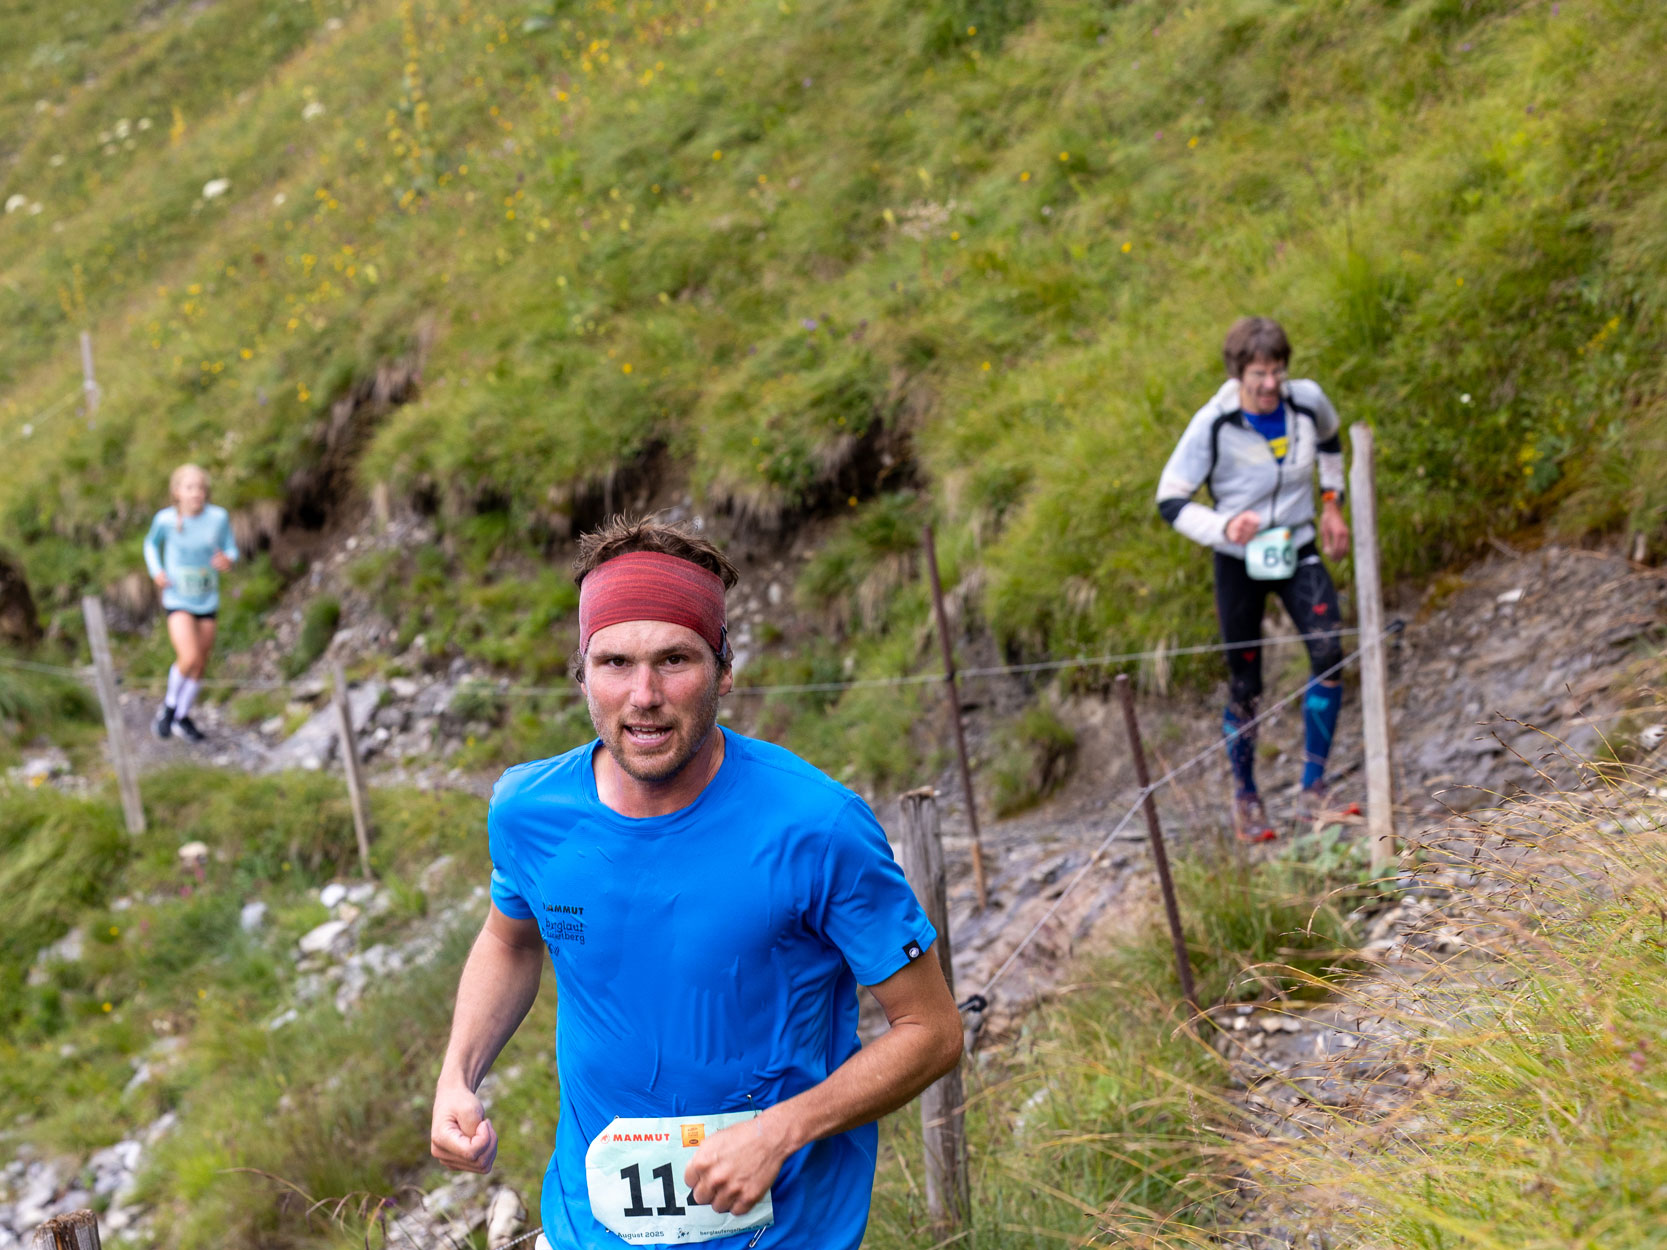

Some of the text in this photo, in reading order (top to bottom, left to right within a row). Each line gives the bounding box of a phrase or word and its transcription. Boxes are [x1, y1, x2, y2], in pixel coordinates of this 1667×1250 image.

[613, 1133, 670, 1142] MAMMUT
[620, 1162, 731, 1217] 11
[617, 1231, 643, 1240] August
